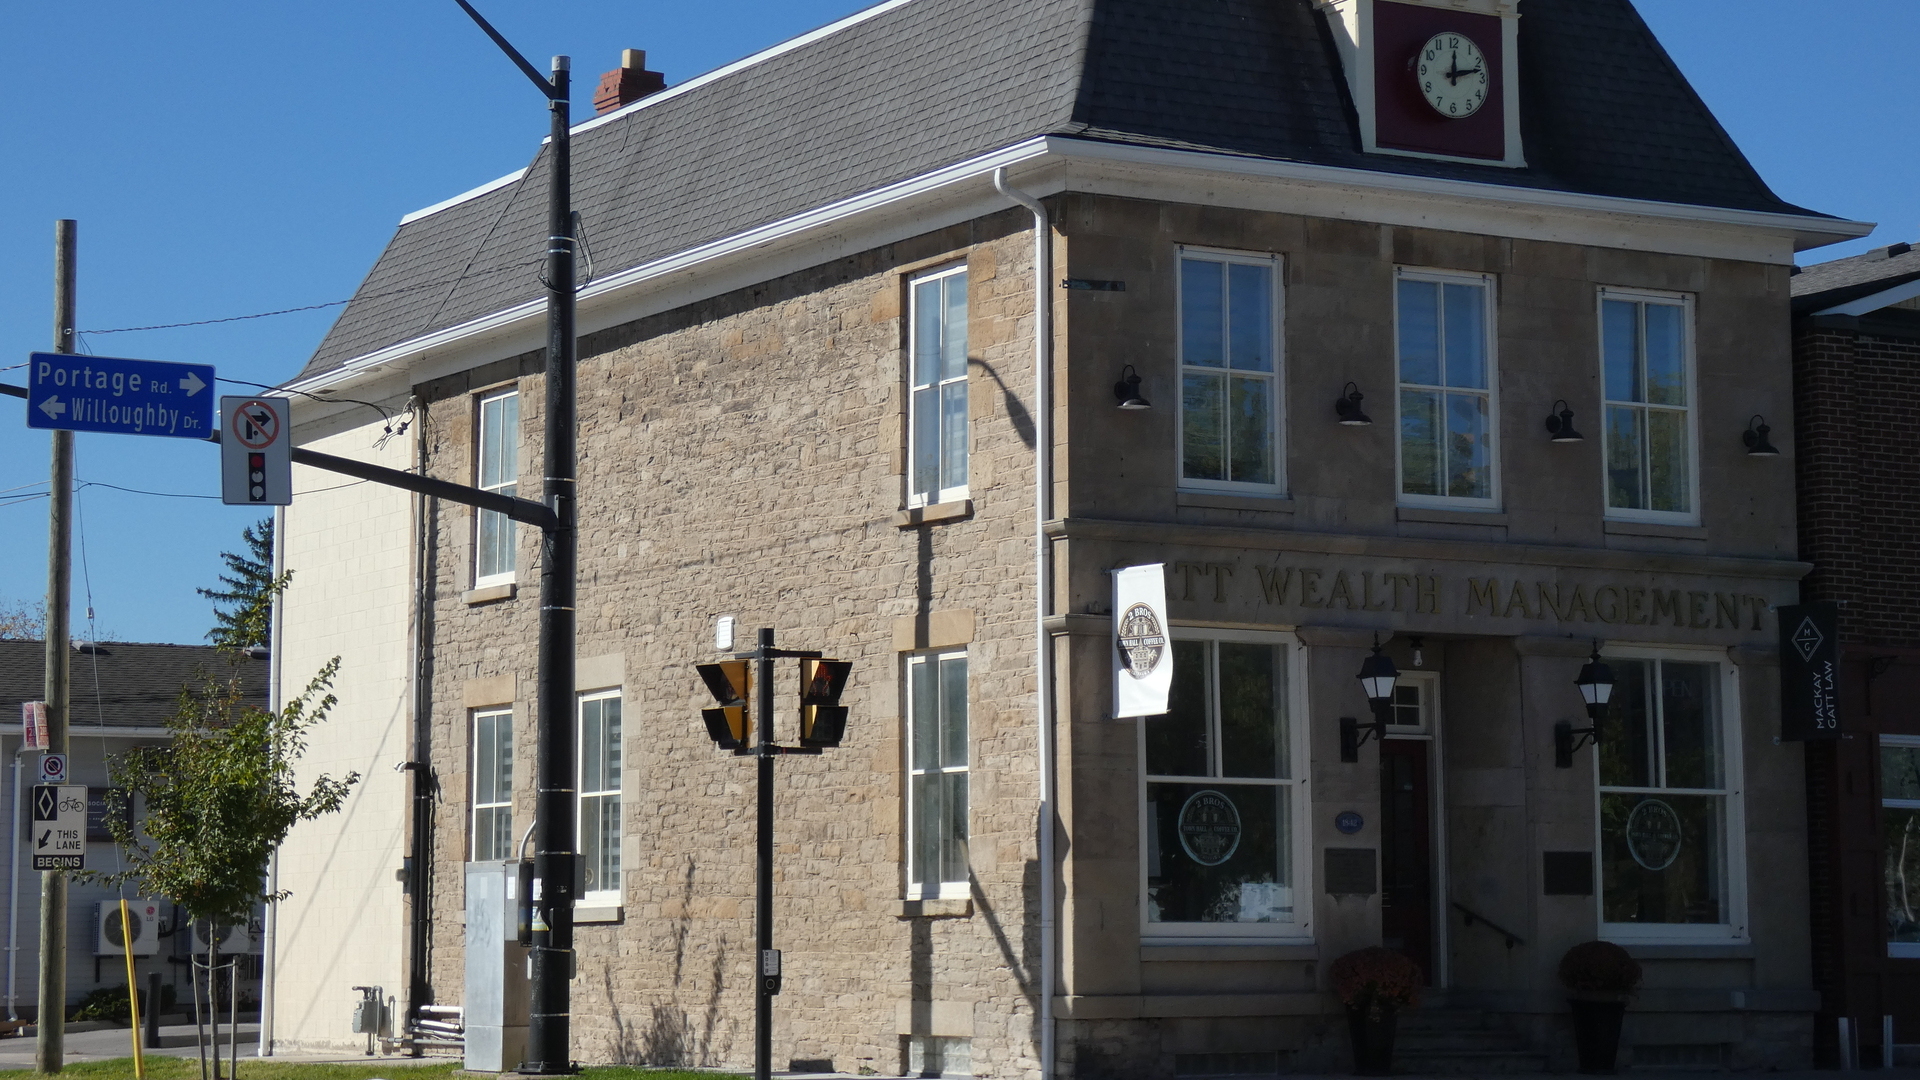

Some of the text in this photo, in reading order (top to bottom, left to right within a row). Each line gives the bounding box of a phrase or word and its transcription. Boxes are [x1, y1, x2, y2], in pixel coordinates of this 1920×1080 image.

[1435, 39, 1442, 50] 11
[1449, 37, 1459, 49] 12
[1425, 49, 1435, 61] 10
[1467, 44, 1471, 55] 1
[1475, 57, 1481, 68] 2
[1420, 64, 1427, 75] 9
[1479, 72, 1485, 84] 3
[1425, 81, 1432, 93] 8
[1475, 89, 1481, 100] 4
[1436, 96, 1443, 107] 7
[1466, 99, 1472, 110] 5
[1450, 102, 1457, 113] 6
[37, 361, 172, 396] Portage Rd.
[71, 396, 201, 434] Willoughby Dr.
[1255, 564, 1442, 614] WEALTH
[1466, 577, 1768, 631] MANAGEMENT
[1128, 607, 1152, 621] 2 BROS
[1804, 628, 1810, 636] M
[1129, 639, 1138, 647] HALL
[1143, 637, 1158, 646] COFFEE
[1804, 643, 1810, 651] G
[1824, 660, 1837, 729] GATT LAW
[1813, 672, 1825, 729] MACKAY
[1196, 797, 1225, 809] 2 BROS
[1648, 806, 1667, 817] BROS
[57, 830, 78, 839] THIS
[56, 840, 81, 850] LANE
[37, 857, 81, 867] BEGINS
